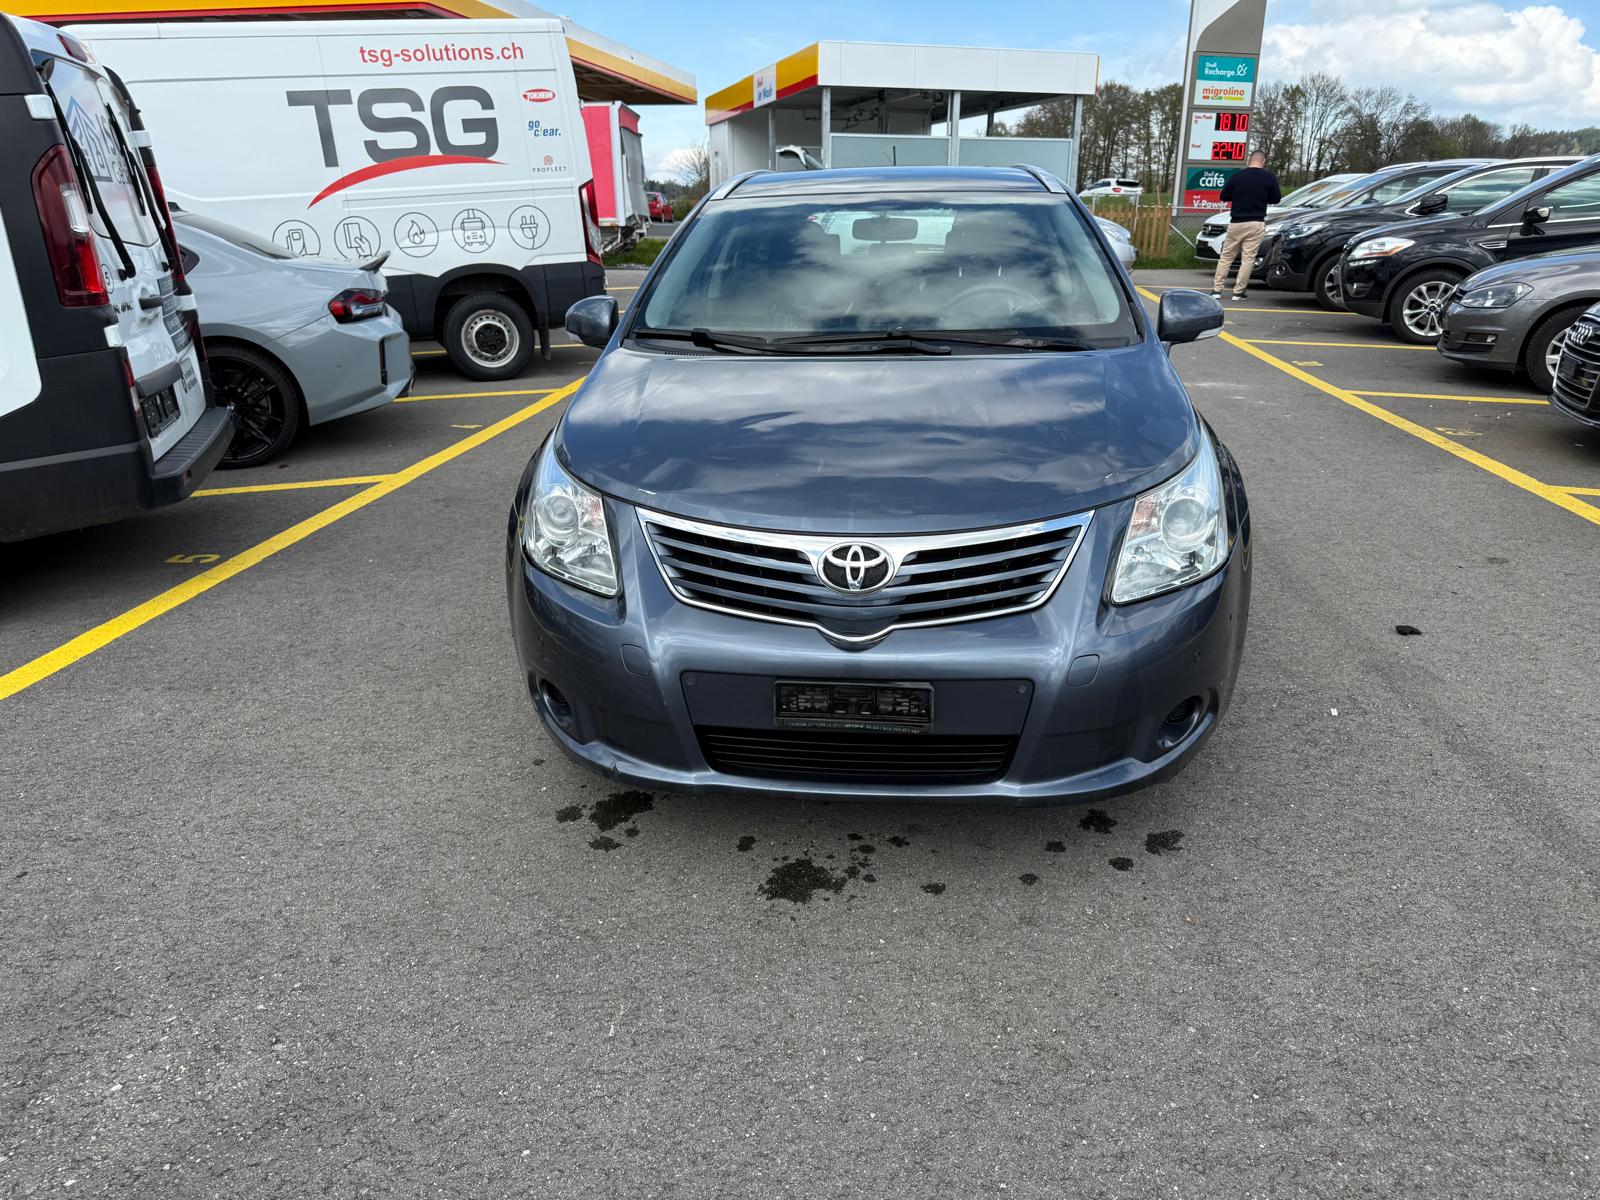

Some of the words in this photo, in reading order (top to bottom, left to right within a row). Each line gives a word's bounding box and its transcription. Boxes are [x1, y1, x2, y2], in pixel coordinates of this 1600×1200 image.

[359, 42, 524, 67] tsg-solutions.ch
[1204, 68, 1235, 77] Recharge
[1202, 86, 1245, 97] migrolino
[285, 85, 499, 168] TSG
[528, 120, 540, 131] go
[1199, 173, 1225, 187] café
